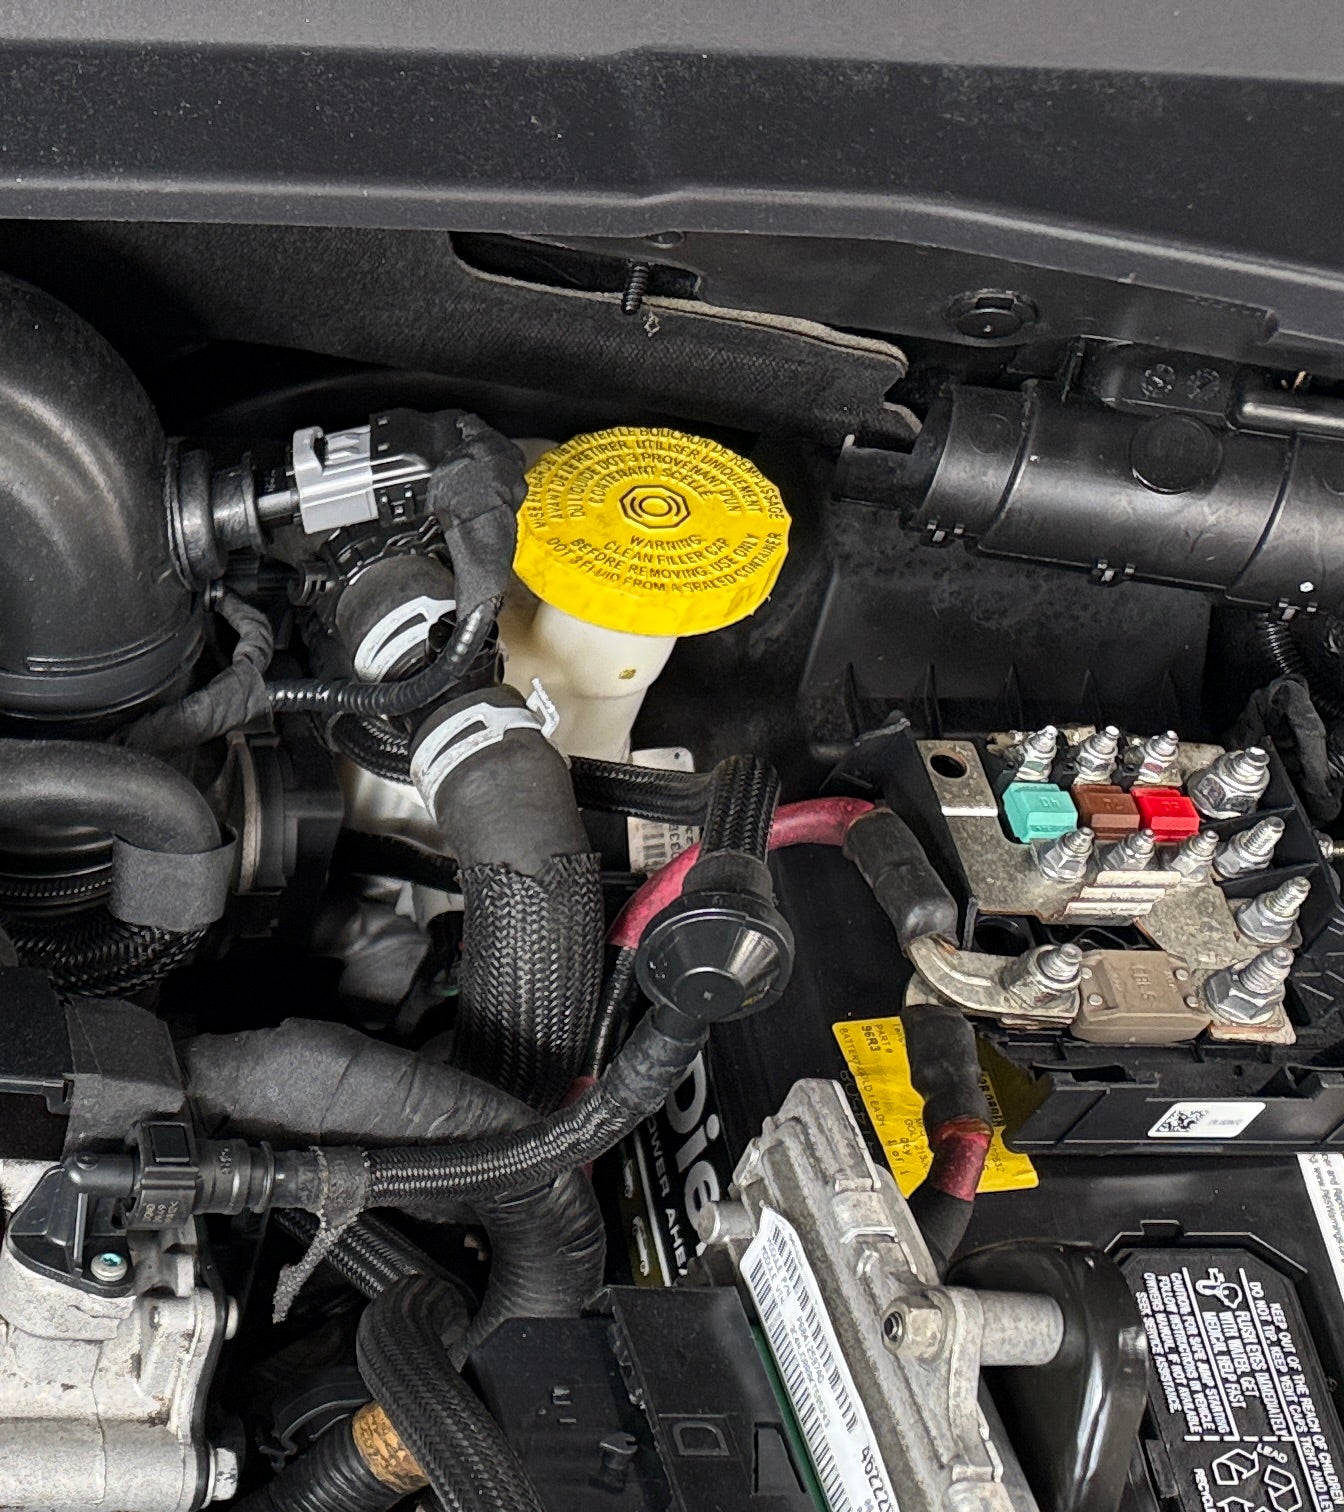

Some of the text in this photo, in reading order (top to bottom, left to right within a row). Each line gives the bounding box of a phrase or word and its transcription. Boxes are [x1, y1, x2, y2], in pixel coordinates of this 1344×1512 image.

[546, 537, 575, 558] DOT
[567, 555, 584, 565] 3
[622, 577, 666, 592] FROM
[681, 573, 737, 593] SEALED
[569, 538, 626, 570] BEFORE
[708, 555, 739, 572] USE
[732, 533, 760, 558] ONLY
[603, 537, 730, 566] CLEAN FILLER CAP
[861, 1025, 882, 1052] 96R3
[666, 1050, 721, 1256] Die
[665, 1208, 688, 1277] AHE
[1248, 1281, 1264, 1299] DO
[1181, 1315, 1199, 1336] FOR
[1254, 1300, 1273, 1323] NOT
[1269, 1302, 1288, 1331] KEEP
[1157, 1275, 1180, 1314] FOLLOW
[1188, 1379, 1203, 1393] IN
[1278, 1332, 1297, 1354] OUT
[1188, 1336, 1208, 1361] SAFE
[1201, 1311, 1248, 1410] MEDICAL HELP FAST
[1218, 1311, 1240, 1338] WITH
[1239, 1376, 1261, 1398] GET
[1245, 1344, 1269, 1372] EYES
[1269, 1346, 1289, 1374] KEEP
[1171, 1364, 1188, 1386] NOT
[1287, 1355, 1303, 1373] OF
[1279, 1374, 1299, 1402] VENT
[1292, 1374, 1311, 1397] THE
[1288, 1403, 1309, 1434] CAPS
[1299, 1397, 1322, 1434] REACH
[1256, 1443, 1289, 1464] LEAD
[1299, 1435, 1320, 1467] TIGHT
[1312, 1435, 1328, 1452] OF
[1309, 1468, 1328, 1493] AND
